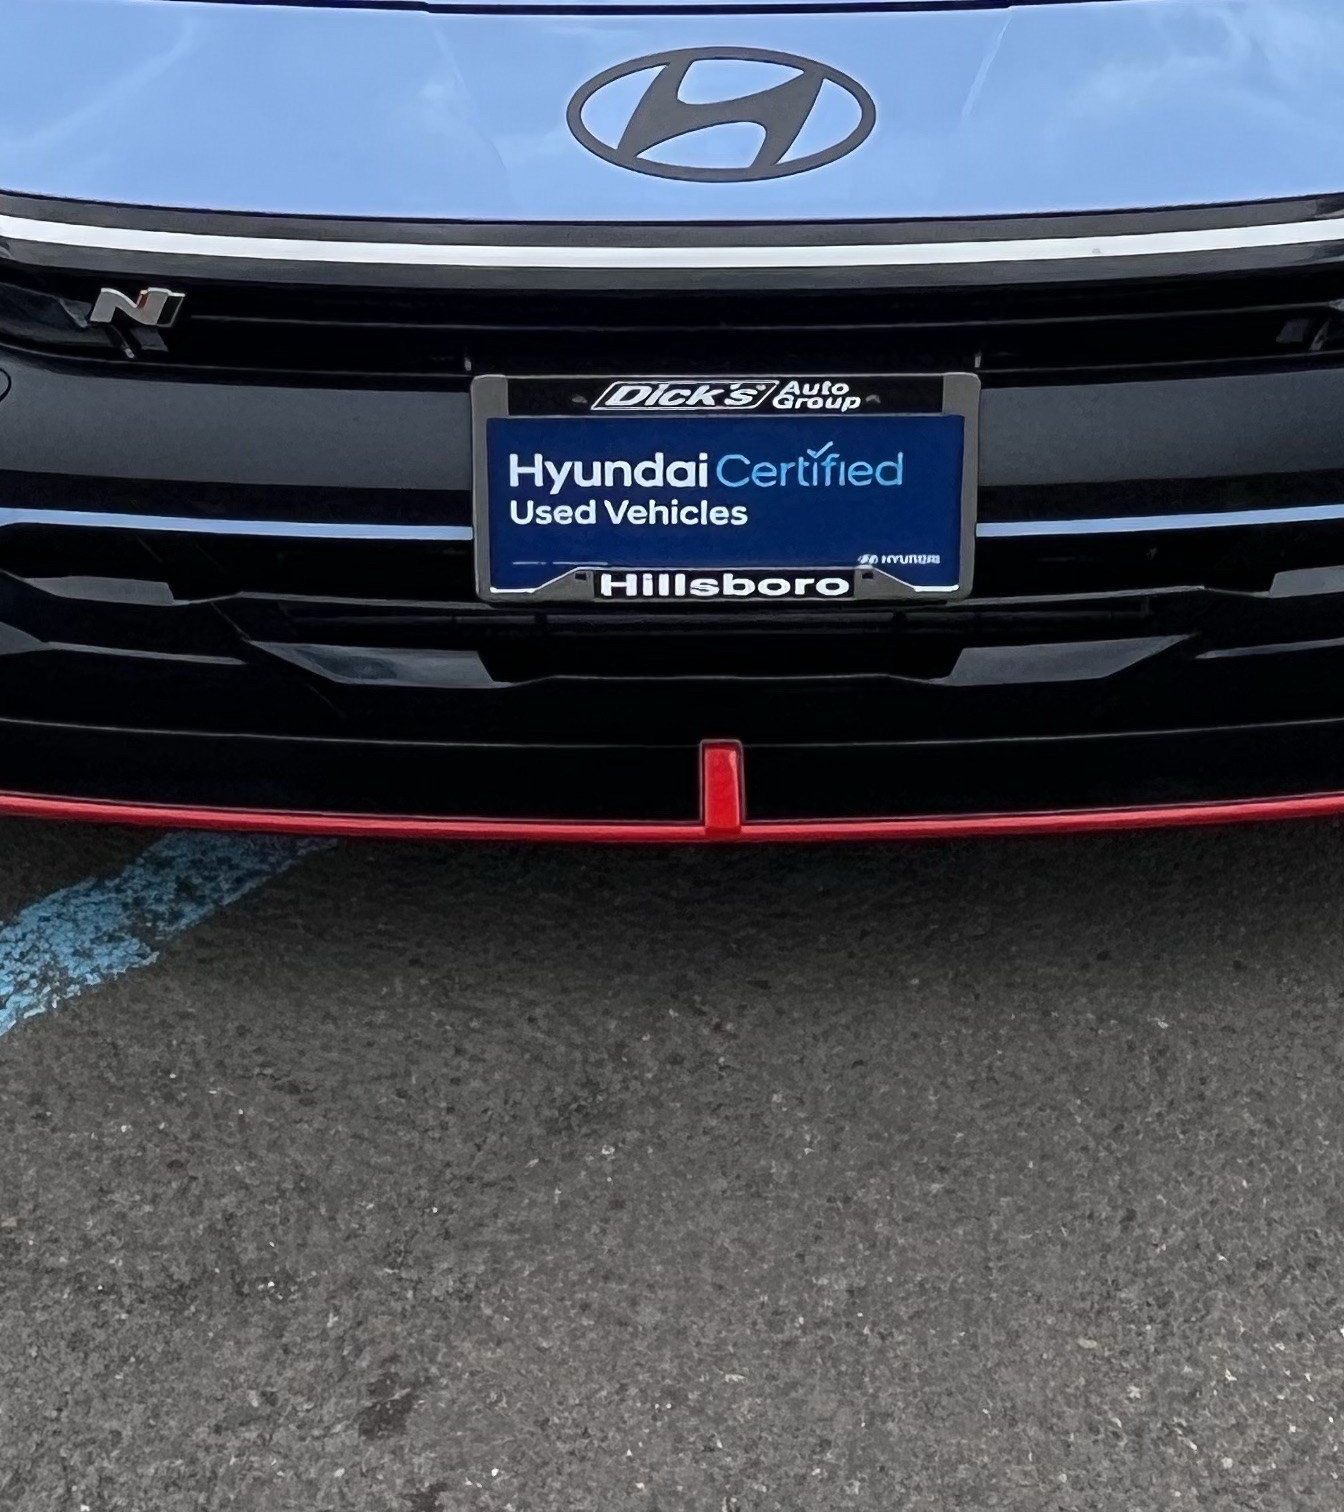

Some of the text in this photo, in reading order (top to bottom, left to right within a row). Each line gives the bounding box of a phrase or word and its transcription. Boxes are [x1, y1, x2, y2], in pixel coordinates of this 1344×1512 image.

[89, 287, 186, 328] N
[778, 380, 850, 396] Auto
[772, 393, 862, 413] Group
[508, 443, 904, 495] Hyundai Certified
[509, 499, 749, 526] Used Vehicles
[600, 573, 850, 597] Hillsboro
